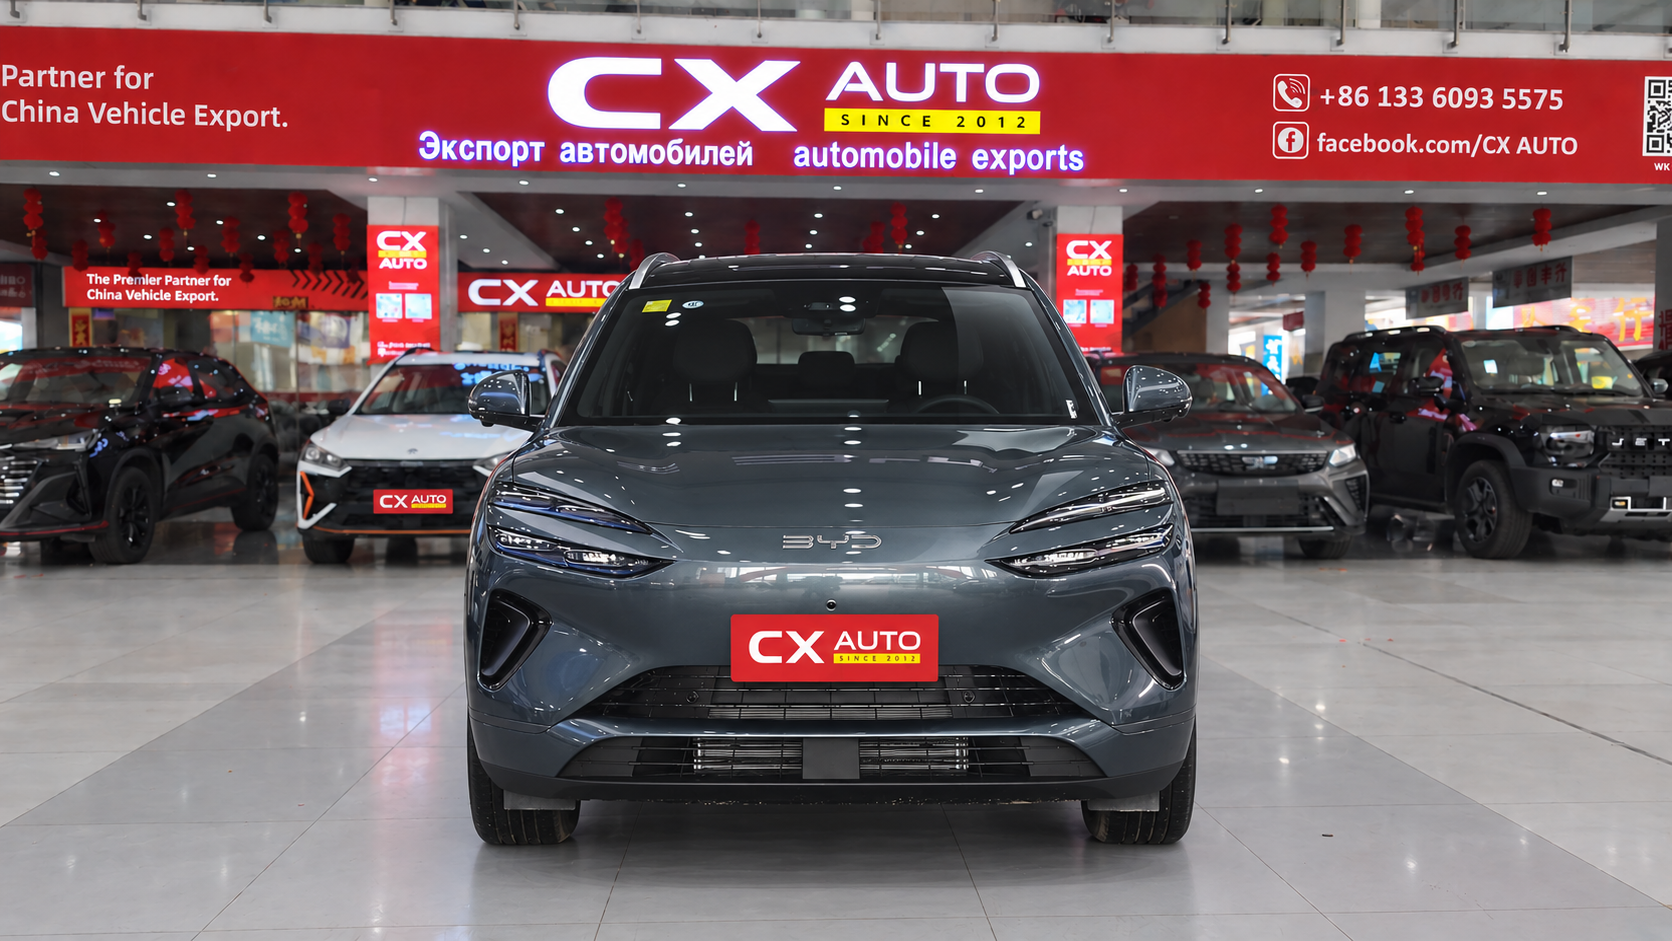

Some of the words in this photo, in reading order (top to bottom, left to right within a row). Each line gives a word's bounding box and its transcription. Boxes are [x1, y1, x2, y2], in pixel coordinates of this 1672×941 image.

[2, 64, 106, 89] Partner
[113, 64, 154, 90] for
[548, 57, 800, 131] CX
[826, 62, 1039, 103] AUTO
[1320, 85, 1369, 107] +86
[1378, 85, 1424, 108] 133
[1432, 86, 1494, 109] 6093
[1502, 88, 1563, 111] 5575
[1, 98, 79, 124] China
[87, 101, 186, 126] Vehicle
[194, 104, 288, 132] Export.
[842, 114, 930, 127] SINCE
[957, 116, 1024, 128] 2012
[417, 131, 545, 167] Экспорт
[560, 138, 752, 165] автомобилей
[1316, 132, 1511, 158] facebook.com/CX
[1515, 136, 1578, 155] AUTO
[794, 142, 956, 169] automobile
[971, 145, 1083, 173] exports
[376, 230, 428, 251] CX
[1065, 239, 1113, 259] CX
[378, 257, 428, 270] AUTO
[1066, 265, 1112, 277] AUTO
[86, 273, 111, 285] The
[164, 274, 211, 286] Partner
[212, 274, 232, 287] for
[86, 288, 123, 301] China
[125, 288, 172, 301] Vehicle
[175, 290, 219, 304] Export.
[467, 278, 539, 307] CX
[379, 494, 408, 509] CX
[410, 494, 448, 505] AUTO
[782, 534, 882, 549] BYD
[749, 631, 824, 663] CX
[834, 631, 920, 650] AUTO
